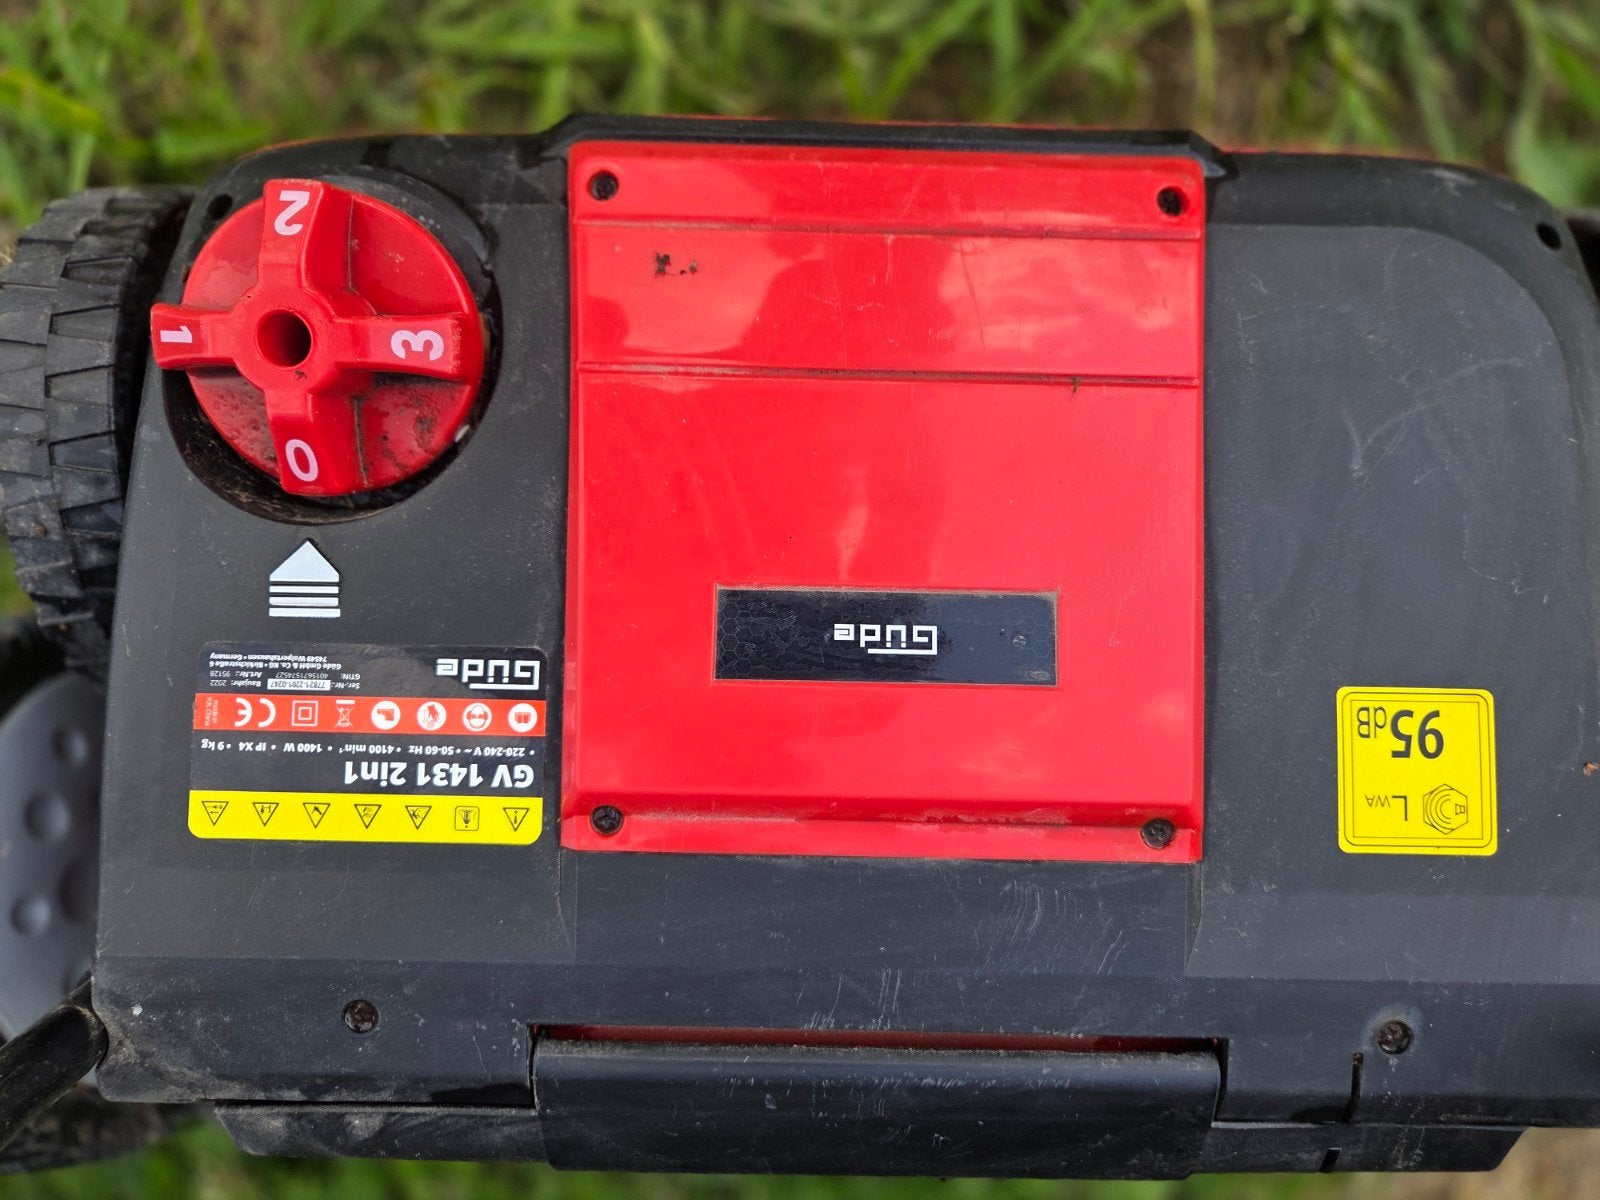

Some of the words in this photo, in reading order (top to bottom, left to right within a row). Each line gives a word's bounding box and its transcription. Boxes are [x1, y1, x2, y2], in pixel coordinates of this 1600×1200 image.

[274, 190, 310, 236] 2
[160, 325, 193, 344] 1
[390, 329, 445, 361] 3
[285, 438, 319, 482] 0
[210, 652, 243, 660] Germany
[299, 662, 322, 670] GmbH
[322, 662, 342, 670] Güde
[437, 659, 540, 690] Güde
[231, 678, 262, 687] Baujahr:
[1356, 706, 1387, 739] dB
[1390, 709, 1444, 760] 95
[200, 738, 216, 750] kg
[217, 740, 224, 750] 9
[238, 741, 254, 751] X4
[255, 742, 266, 751] IP
[282, 742, 295, 752] W
[298, 742, 322, 753] 1400
[369, 744, 394, 754] 4100
[408, 745, 423, 754] Hz
[426, 746, 454, 755] 50-60
[473, 746, 482, 756] V
[483, 746, 525, 757] 220-240
[344, 761, 407, 786] 2in1
[415, 762, 484, 787] 1431
[491, 764, 534, 788] GV
